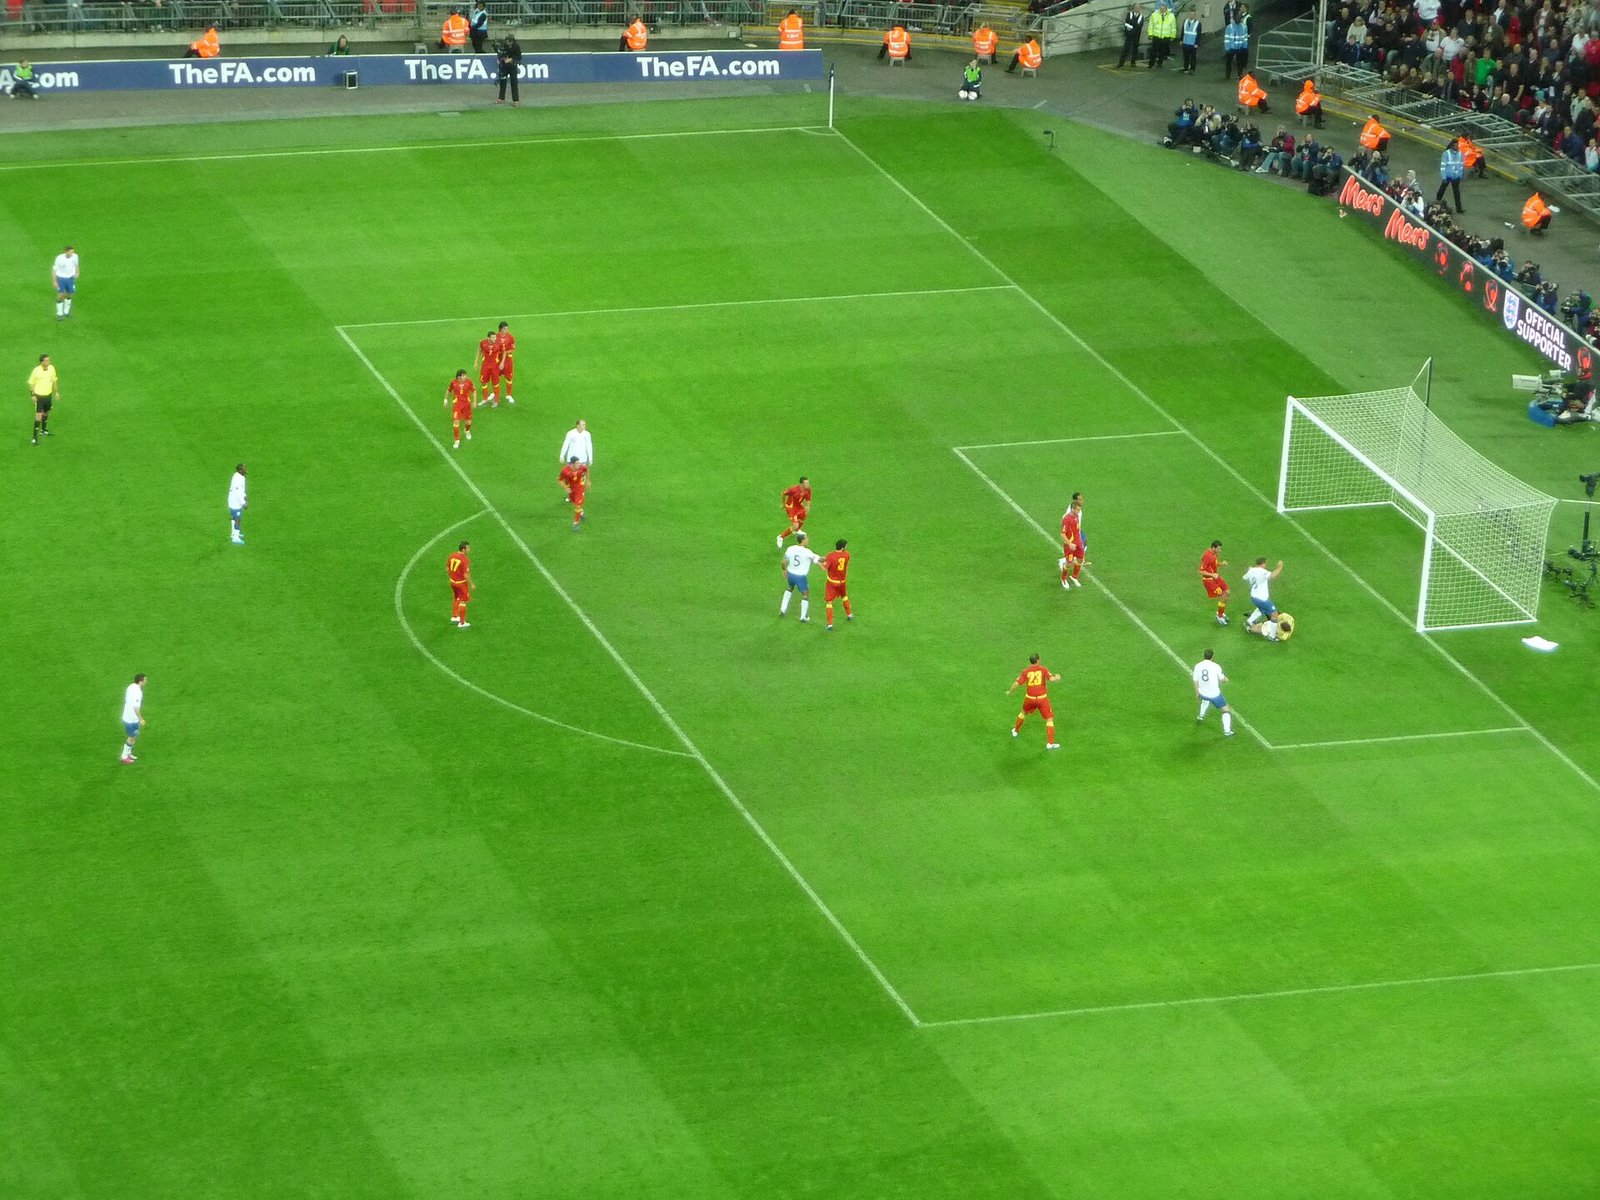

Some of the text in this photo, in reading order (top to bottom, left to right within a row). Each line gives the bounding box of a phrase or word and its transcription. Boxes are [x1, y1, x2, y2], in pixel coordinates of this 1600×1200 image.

[169, 62, 316, 84] TheFA.com
[404, 58, 549, 80] TheFA.om
[636, 55, 780, 77] TheFA.com
[1340, 175, 1385, 217] Mars
[1384, 208, 1430, 250] Mars
[1525, 307, 1565, 349] OFFICIAL
[1516, 319, 1572, 371] SUPPORTER
[449, 557, 461, 572] 17
[793, 554, 801, 568] 5
[838, 557, 846, 571] 3
[1027, 670, 1042, 686] 23
[1201, 669, 1210, 682] 8
